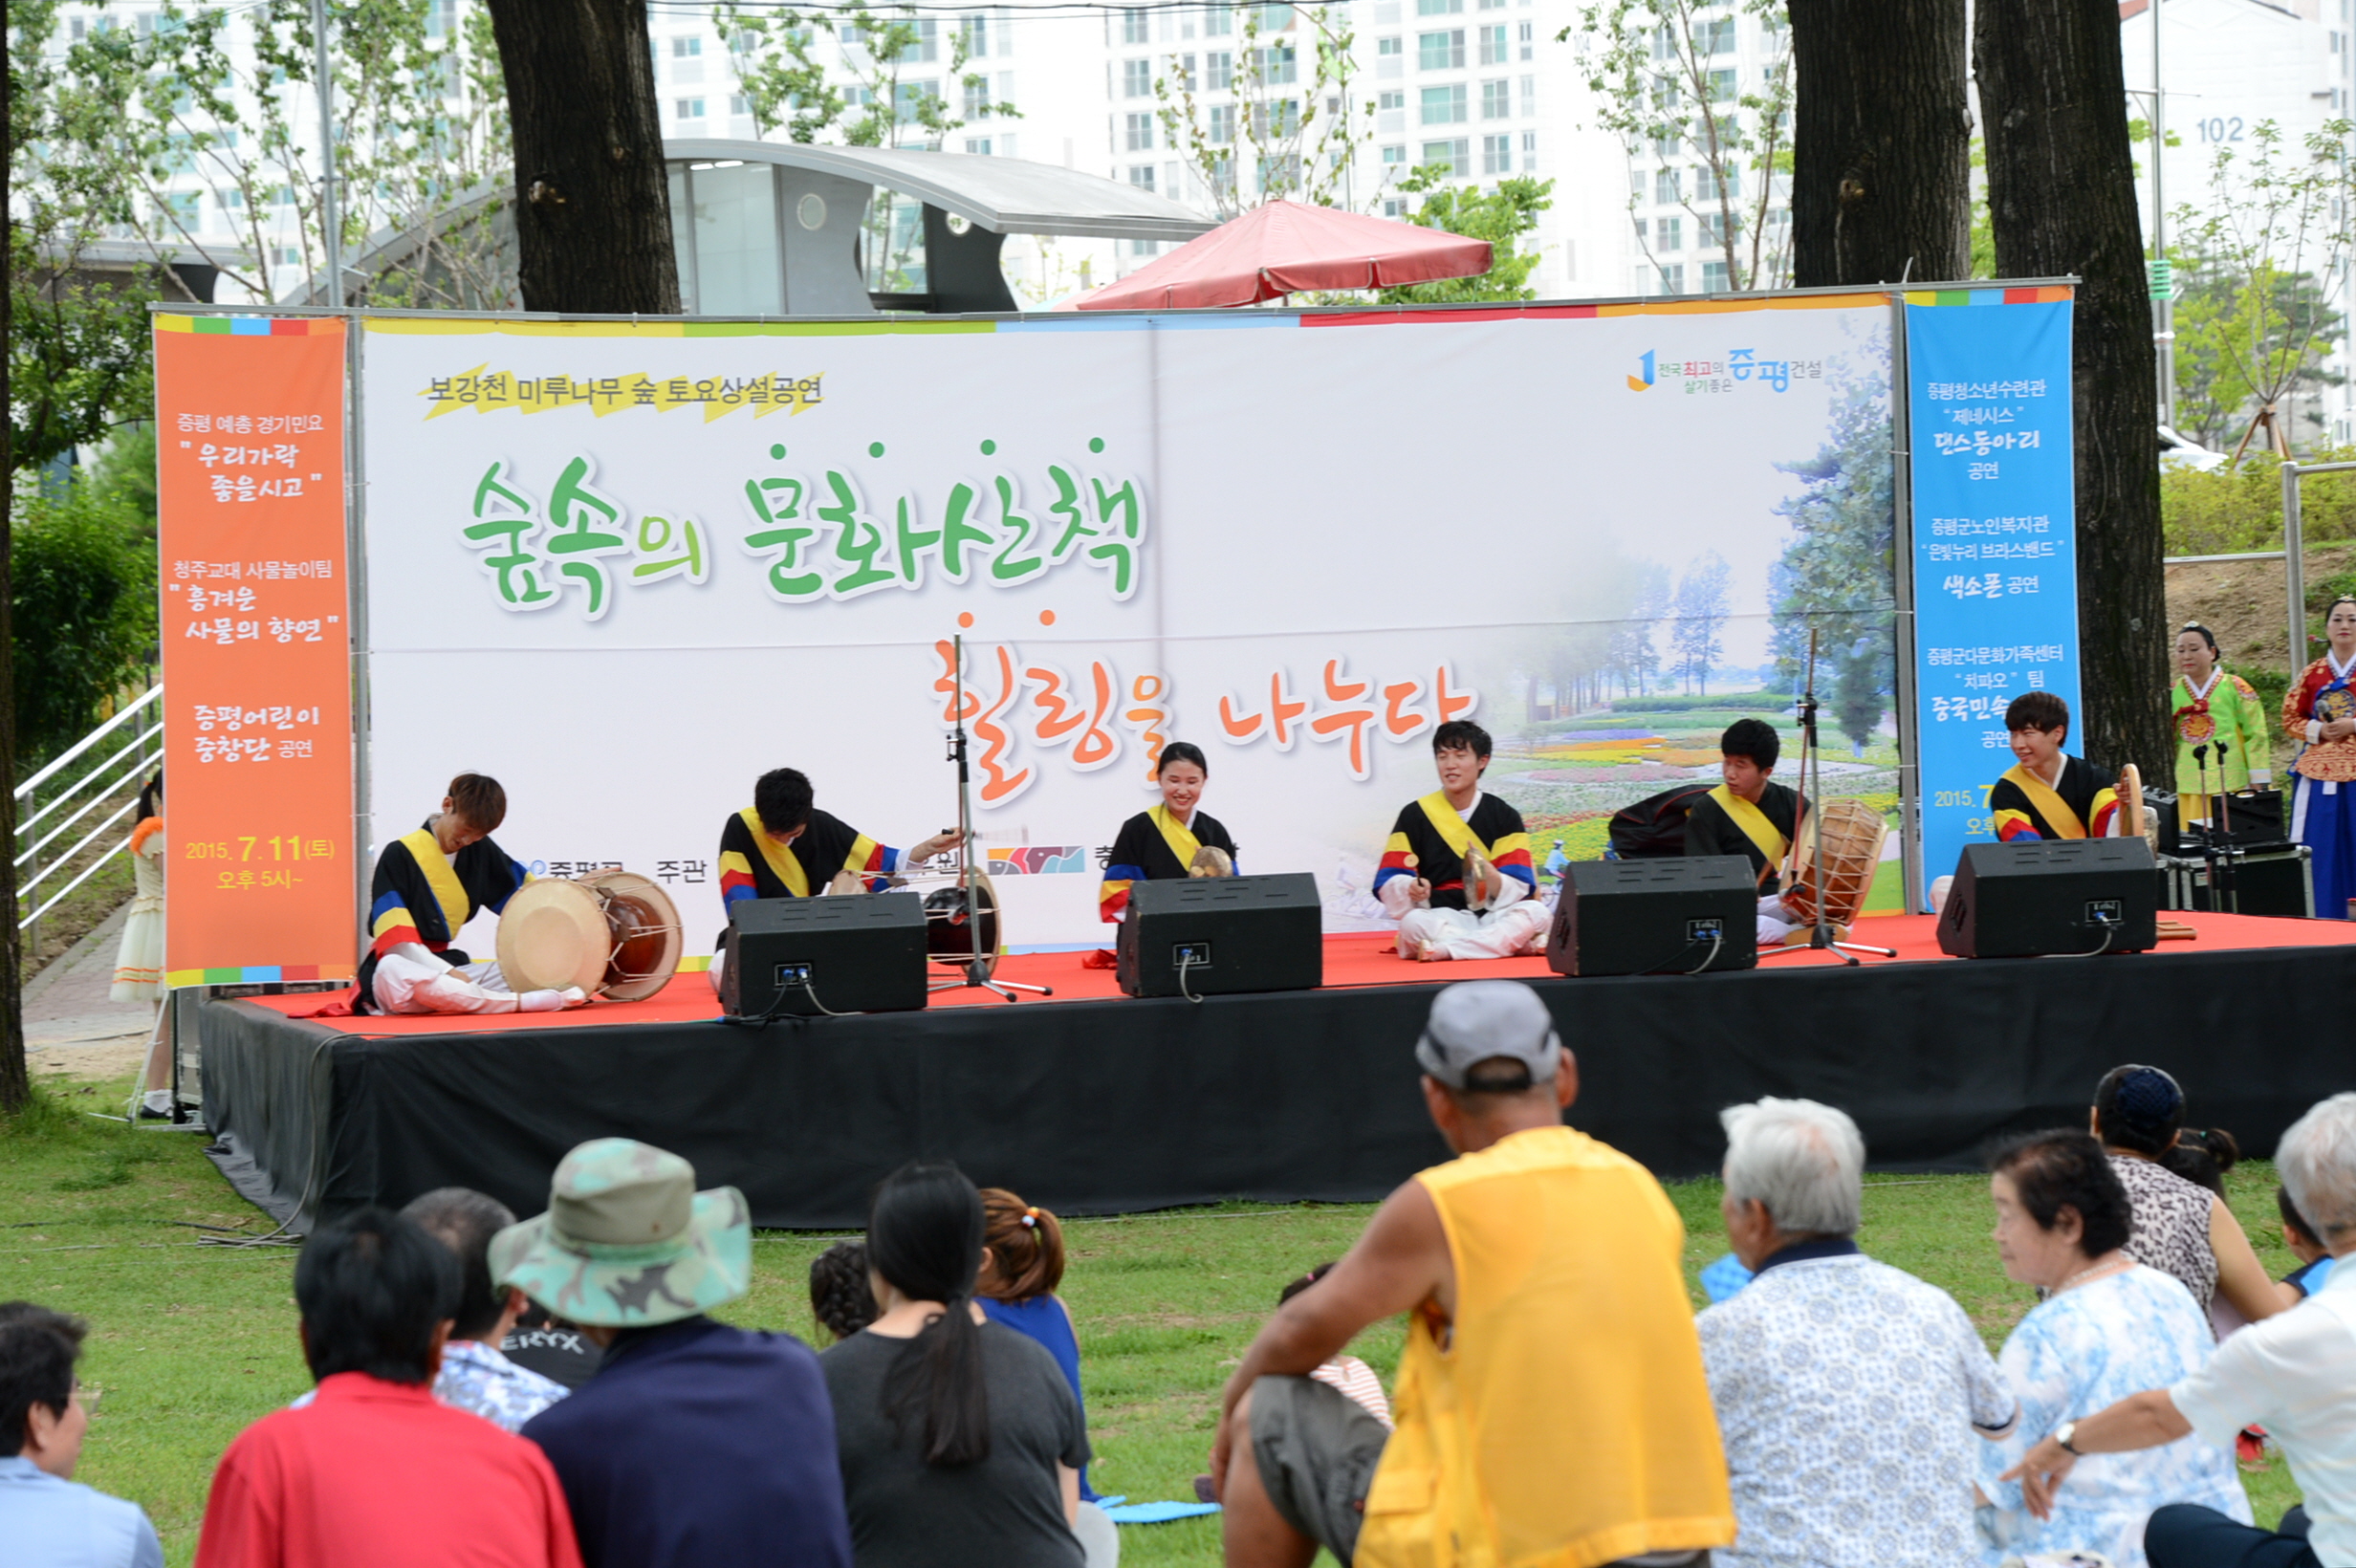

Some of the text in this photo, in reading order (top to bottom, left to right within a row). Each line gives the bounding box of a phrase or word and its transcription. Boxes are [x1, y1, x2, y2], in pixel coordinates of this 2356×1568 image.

[2196, 117, 2244, 142] 102
[1658, 348, 1822, 393] 전국 최고의 증평 건설
[427, 374, 823, 405] 보강천 미루나무 숲 토요상설공연
[1927, 379, 2047, 401] 증평청소년수련관
[177, 413, 325, 434] 증평 예총 경기민요
[1933, 429, 2040, 456] 댄스동아리
[1967, 461, 1999, 480] 공연
[744, 464, 1139, 596] 문화산책
[1931, 514, 2050, 536] 증평군노인복지관
[173, 559, 333, 579] 청주교대 사물놀이팀
[1942, 573, 2040, 599] 색소폰 공연
[185, 617, 261, 645] 사물의
[1927, 643, 2064, 666] 증평군다문화가족센터
[2027, 670, 2045, 688] 팀
[193, 705, 319, 731] 증평어린이
[933, 639, 1472, 802] 힐링을 나누다
[193, 735, 313, 764] 중창단 공연
[1980, 730, 2011, 749] 공연
[1965, 816, 1996, 836] 오후
[216, 870, 256, 890] 오후
[657, 860, 708, 884] 주관
